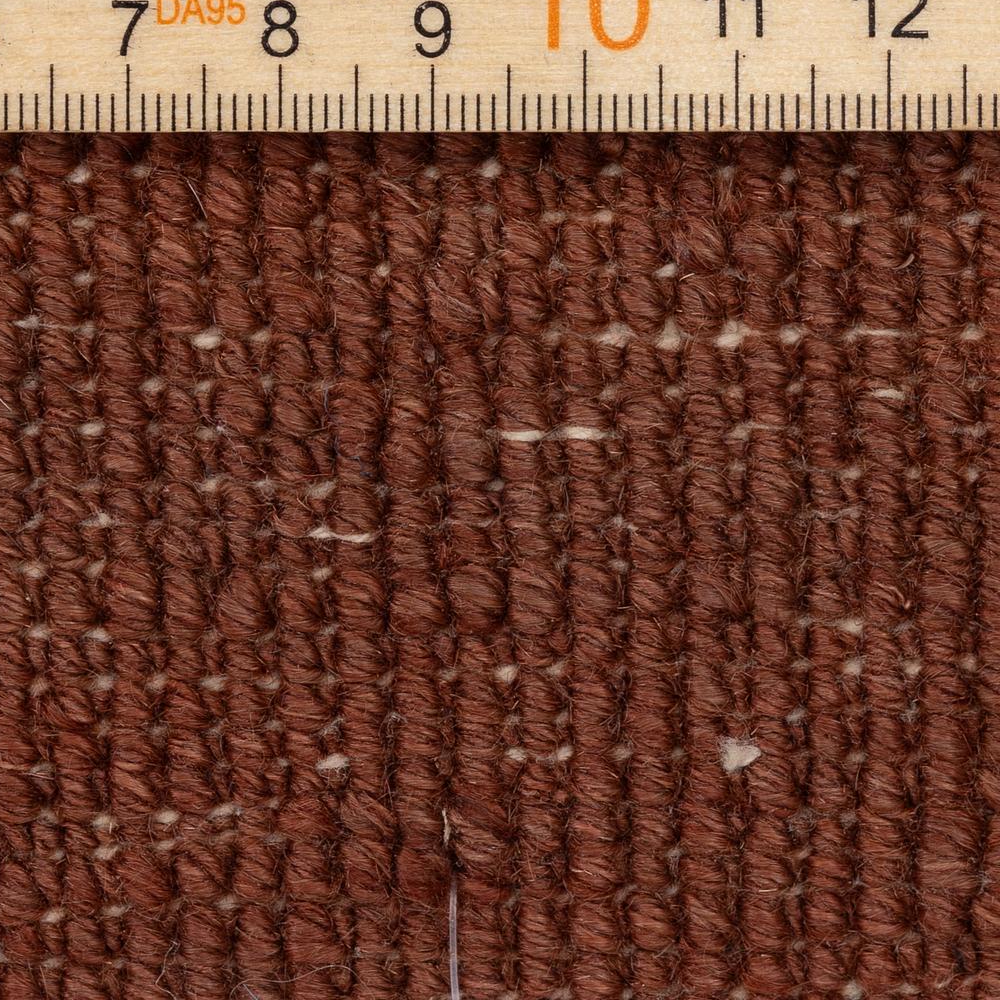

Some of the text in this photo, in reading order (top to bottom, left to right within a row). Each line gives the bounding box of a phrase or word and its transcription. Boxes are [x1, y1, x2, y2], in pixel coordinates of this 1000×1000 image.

[111, 0, 149, 57] 7
[260, 0, 300, 58] 8
[413, 0, 453, 59] 9
